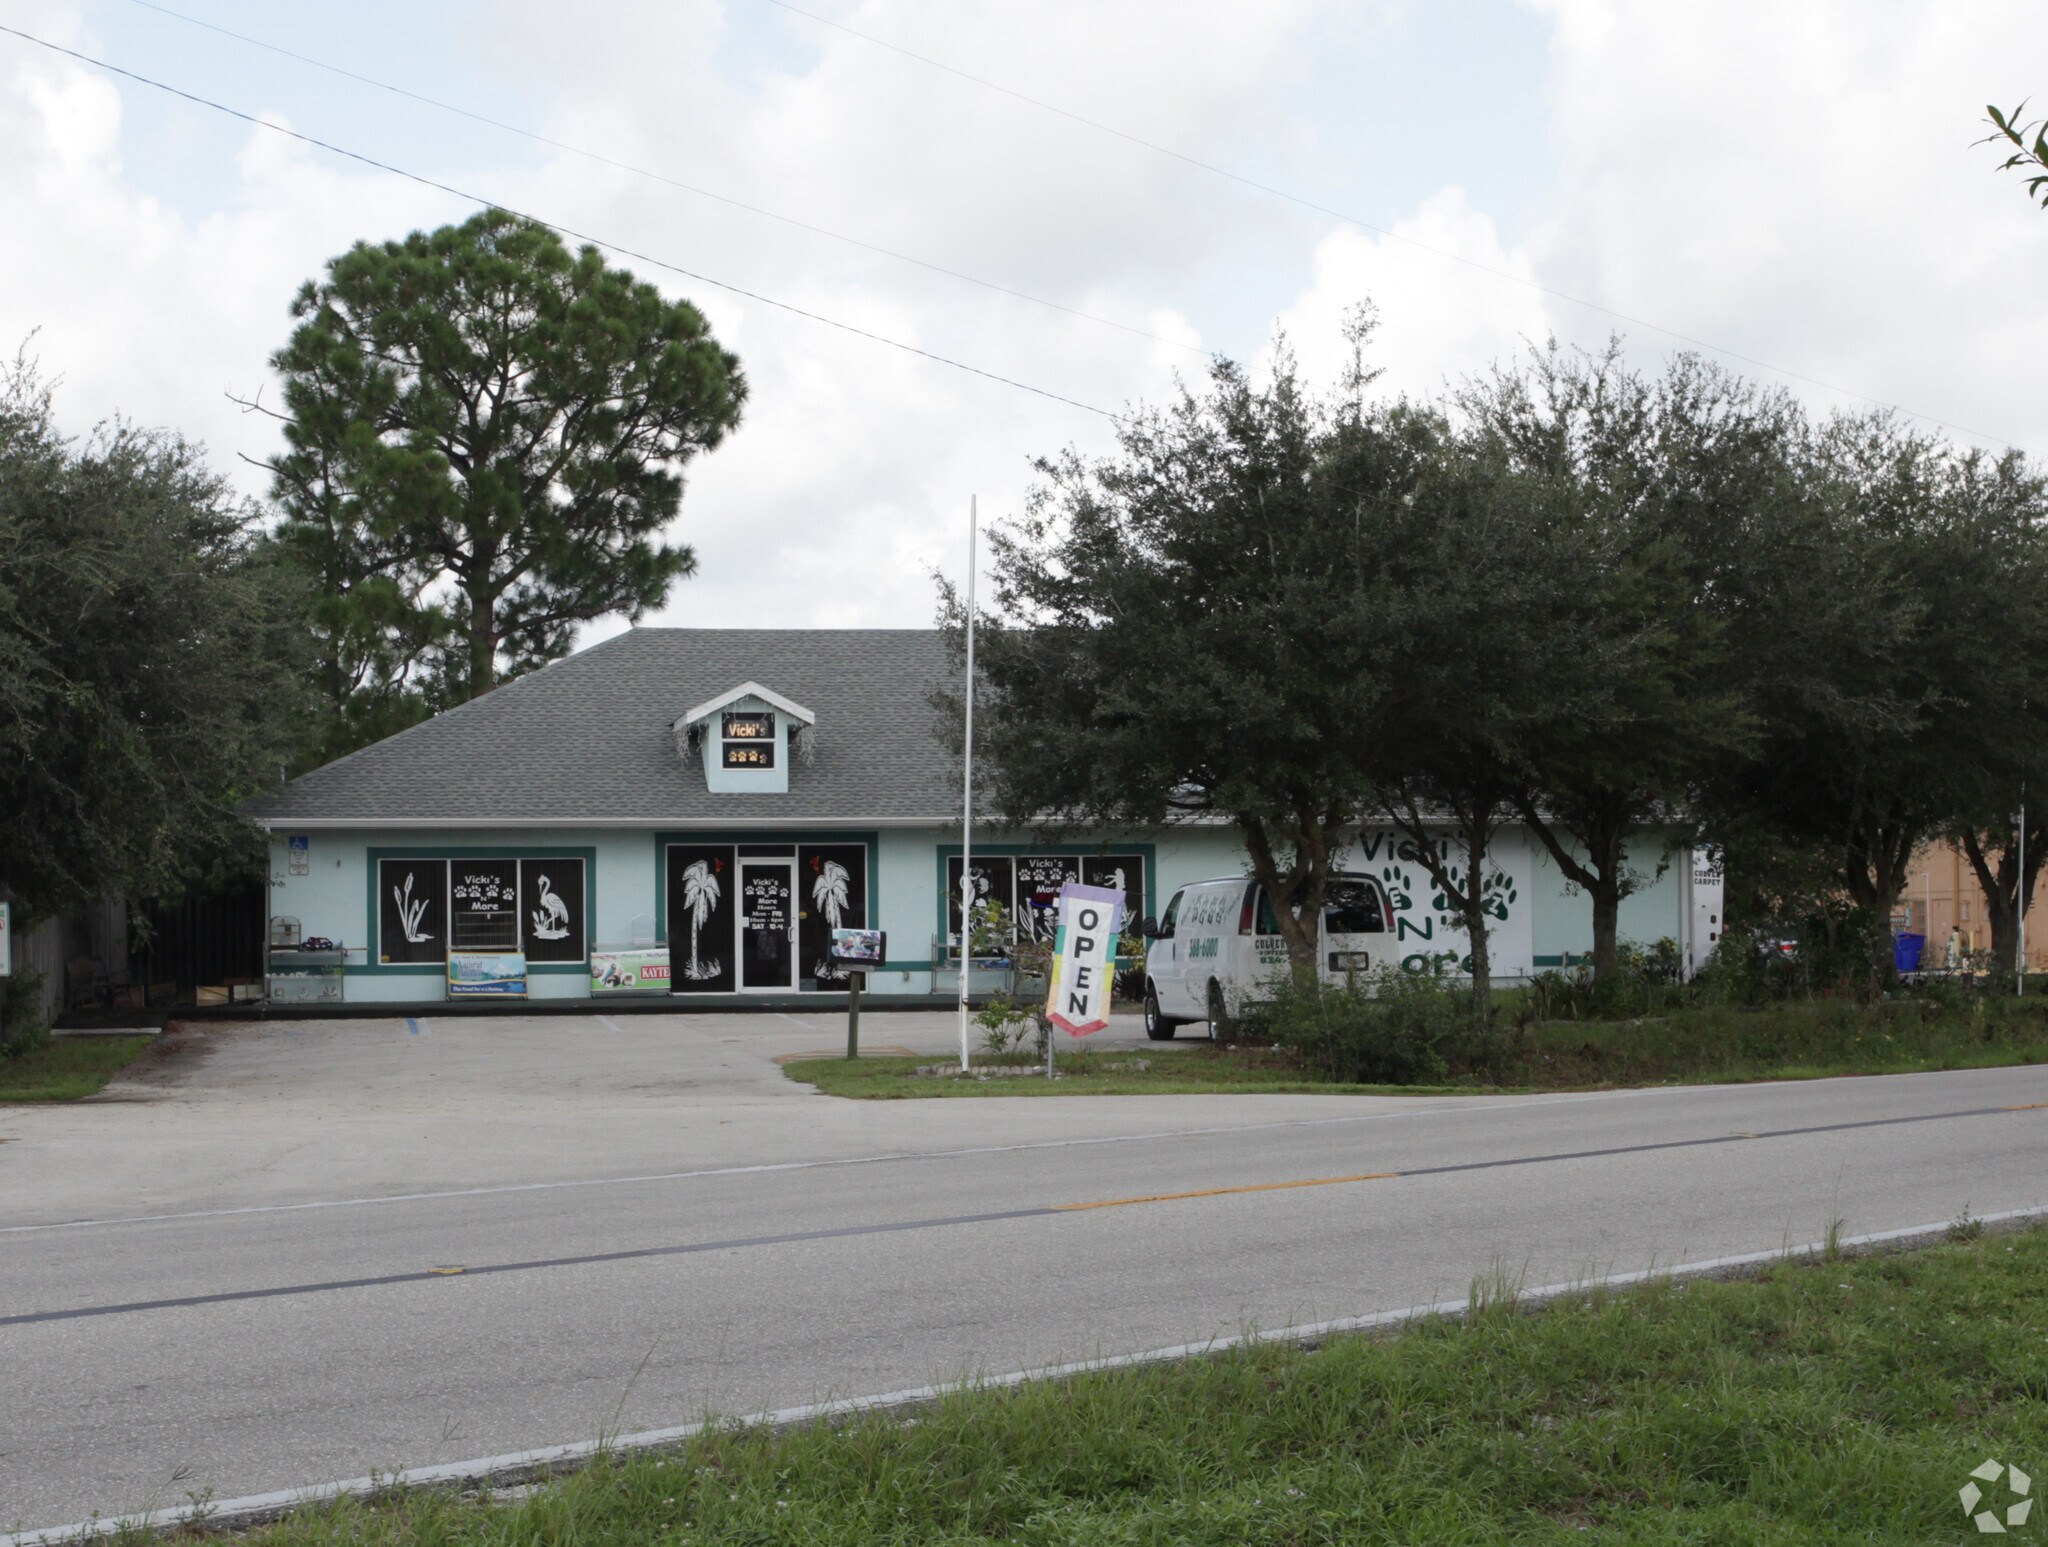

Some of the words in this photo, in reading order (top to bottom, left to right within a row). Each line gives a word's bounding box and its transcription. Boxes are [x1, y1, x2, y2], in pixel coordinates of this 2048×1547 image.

[729, 723, 766, 737] Vicki's
[1359, 830, 1486, 862] Vici'
[1029, 859, 1064, 868] Vicki's
[464, 875, 501, 885] Vicki's
[1694, 878, 1721, 886] CARPET
[1036, 885, 1062, 893] More
[471, 901, 499, 911] More
[1069, 908, 1099, 1016] OPEN
